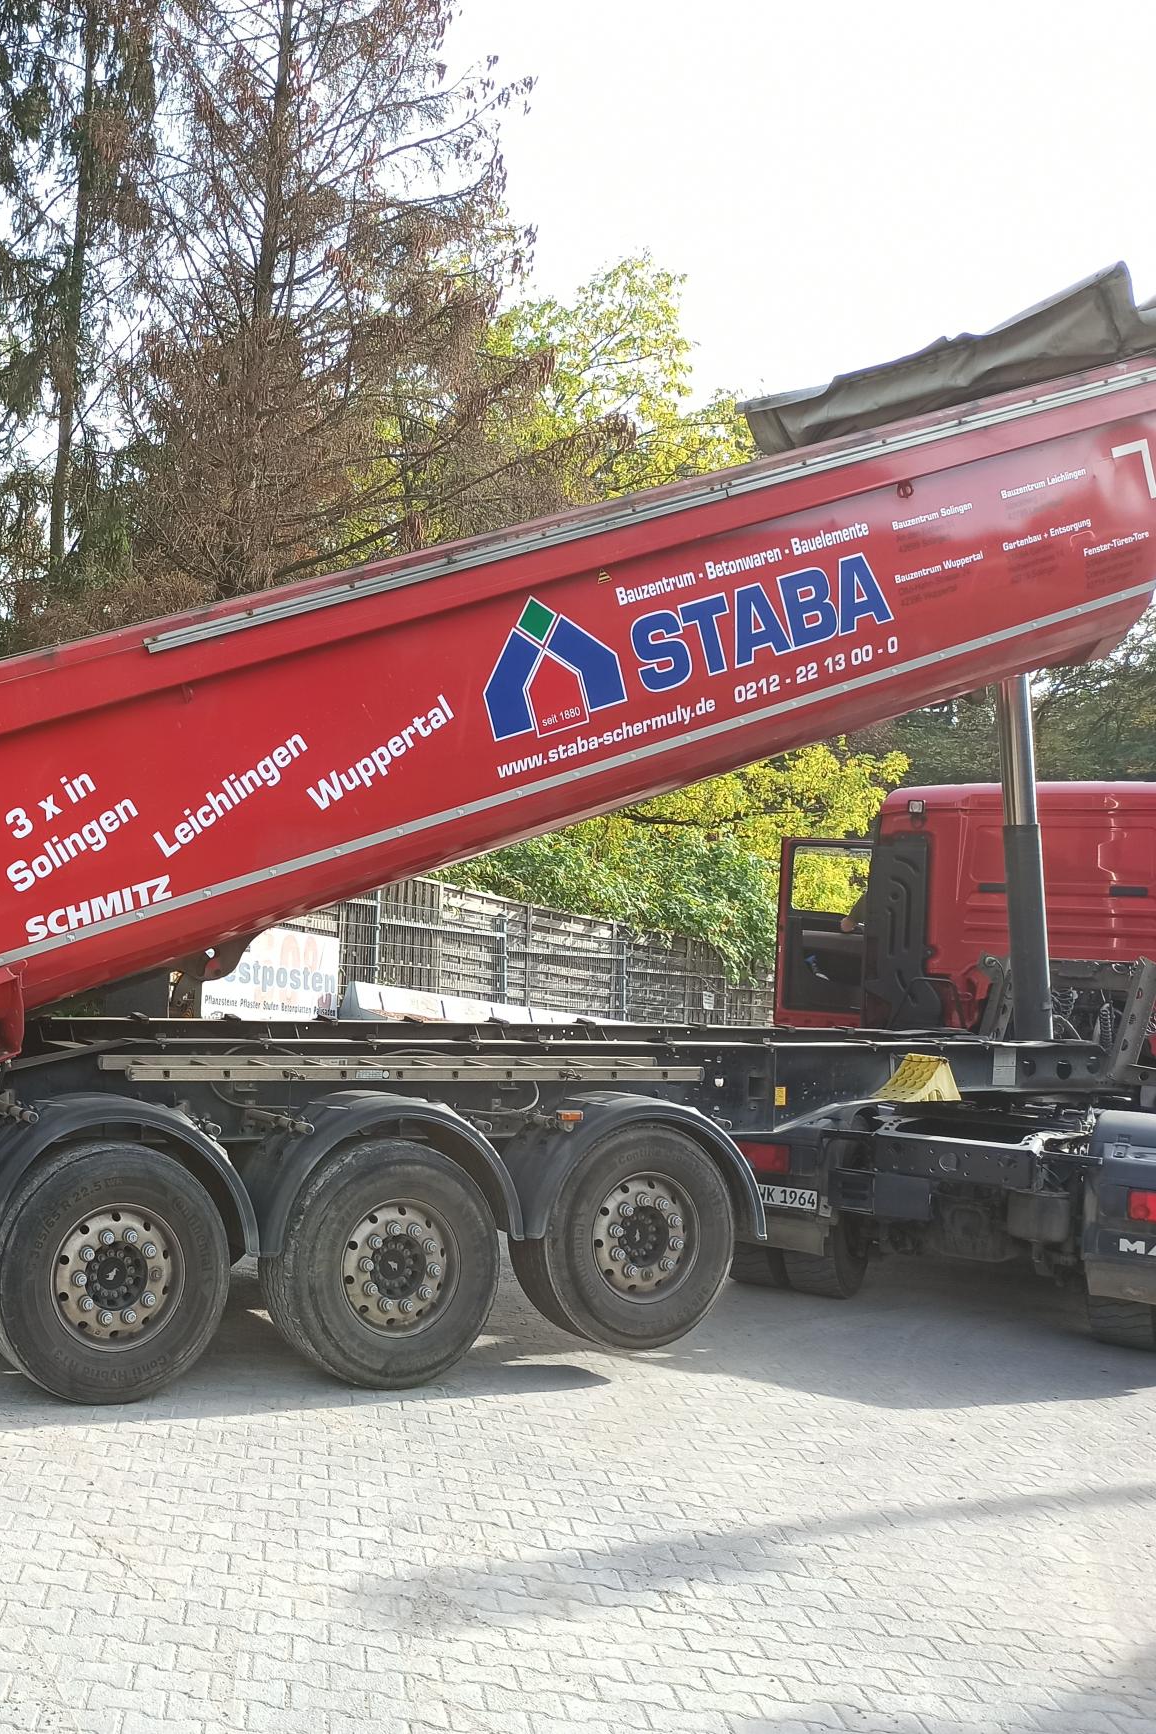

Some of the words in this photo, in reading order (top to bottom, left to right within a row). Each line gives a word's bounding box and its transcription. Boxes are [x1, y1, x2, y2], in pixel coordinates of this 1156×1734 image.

[892, 511, 939, 530] Bauzentrum
[940, 502, 973, 518] Solingen
[1000, 480, 1045, 499] Bauzentrum
[1046, 467, 1086, 486] Leichlingen
[616, 571, 696, 606] Bauzentrum
[705, 545, 782, 580] Betonwaren
[791, 522, 869, 556] Bauelemente
[894, 564, 942, 583] Bauzentrum
[943, 551, 984, 570] Wuppertal
[1003, 533, 1042, 551] Gartenbau
[1050, 518, 1092, 538] Entsorgung
[1083, 530, 1150, 557] Fenster-Türen-Tore
[630, 552, 895, 693] STABA
[734, 674, 780, 703] 0212
[796, 662, 819, 684] 22
[825, 653, 845, 675] 13
[851, 644, 873, 665] 00
[887, 636, 898, 653] 0
[497, 697, 716, 779] www.staba-schermuly.de
[542, 715, 559, 727] seit
[559, 706, 581, 722] 1880
[306, 694, 455, 811] Wuppertal
[5, 807, 34, 839] 3
[38, 794, 63, 822] x
[59, 772, 96, 804] in
[152, 732, 309, 858] Leichlingen
[6, 797, 139, 892] Solingen
[25, 874, 172, 943] SCHMITZ
[205, 995, 238, 1007] Pflanzsteine
[240, 998, 261, 1009] Pflaster
[263, 1000, 279, 1010] Stufen
[281, 1002, 312, 1015] Betonplatten
[780, 1189, 815, 1207] 1964
